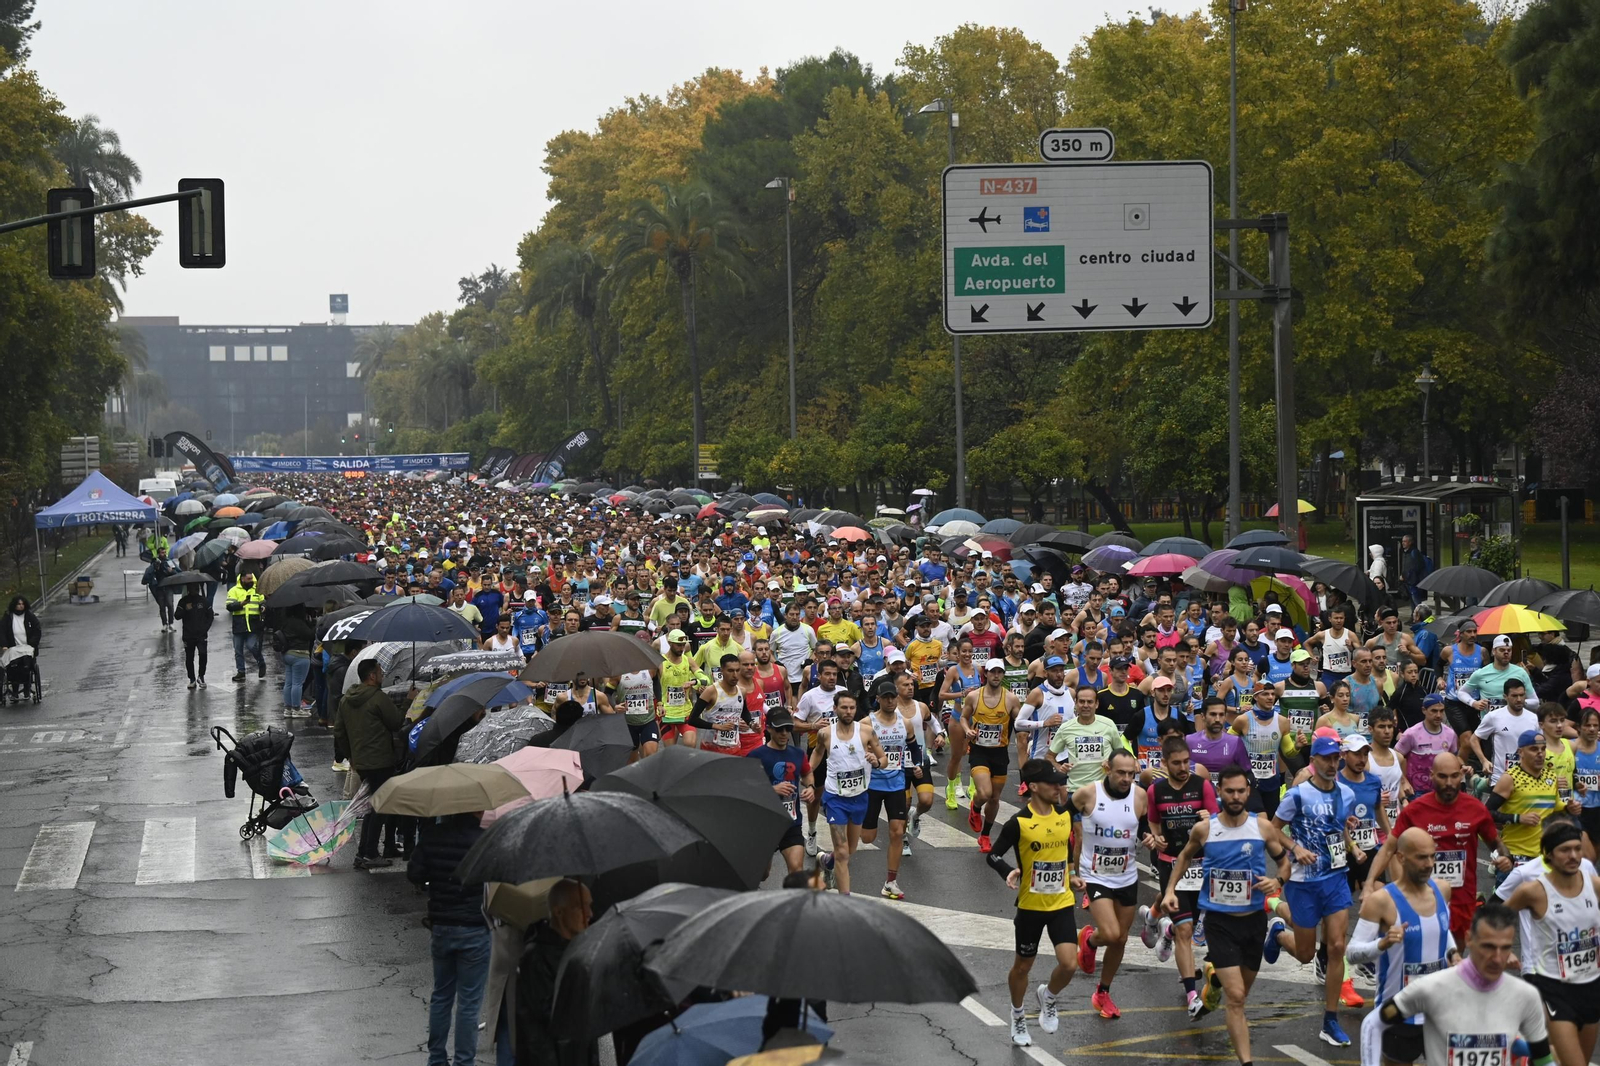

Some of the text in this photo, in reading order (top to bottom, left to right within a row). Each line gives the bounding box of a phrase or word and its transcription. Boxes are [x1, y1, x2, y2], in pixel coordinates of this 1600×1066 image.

[1051, 139, 1103, 152] 350 m
[984, 180, 1033, 194] N-437
[971, 252, 1048, 267] Avda. del
[1079, 250, 1196, 264] centro ciudad
[964, 276, 1056, 292] Aeropuerto
[566, 431, 587, 450] POWER
[332, 460, 370, 468] SALIDA
[75, 511, 146, 522] TROTASIERRA
[923, 668, 937, 676] 2026
[1292, 717, 1310, 725] 1472
[1078, 744, 1101, 752] 2382
[1252, 761, 1273, 770] 2024
[841, 777, 862, 789] 2357
[1166, 804, 1192, 814] LUCAS
[1351, 830, 1372, 840] 2187
[1097, 857, 1124, 866] 1640
[1434, 863, 1461, 874] 1261
[1036, 872, 1062, 882] 1083
[1218, 881, 1242, 893] 793
[1565, 950, 1596, 968] 1649
[1455, 1050, 1500, 1066] 1975
